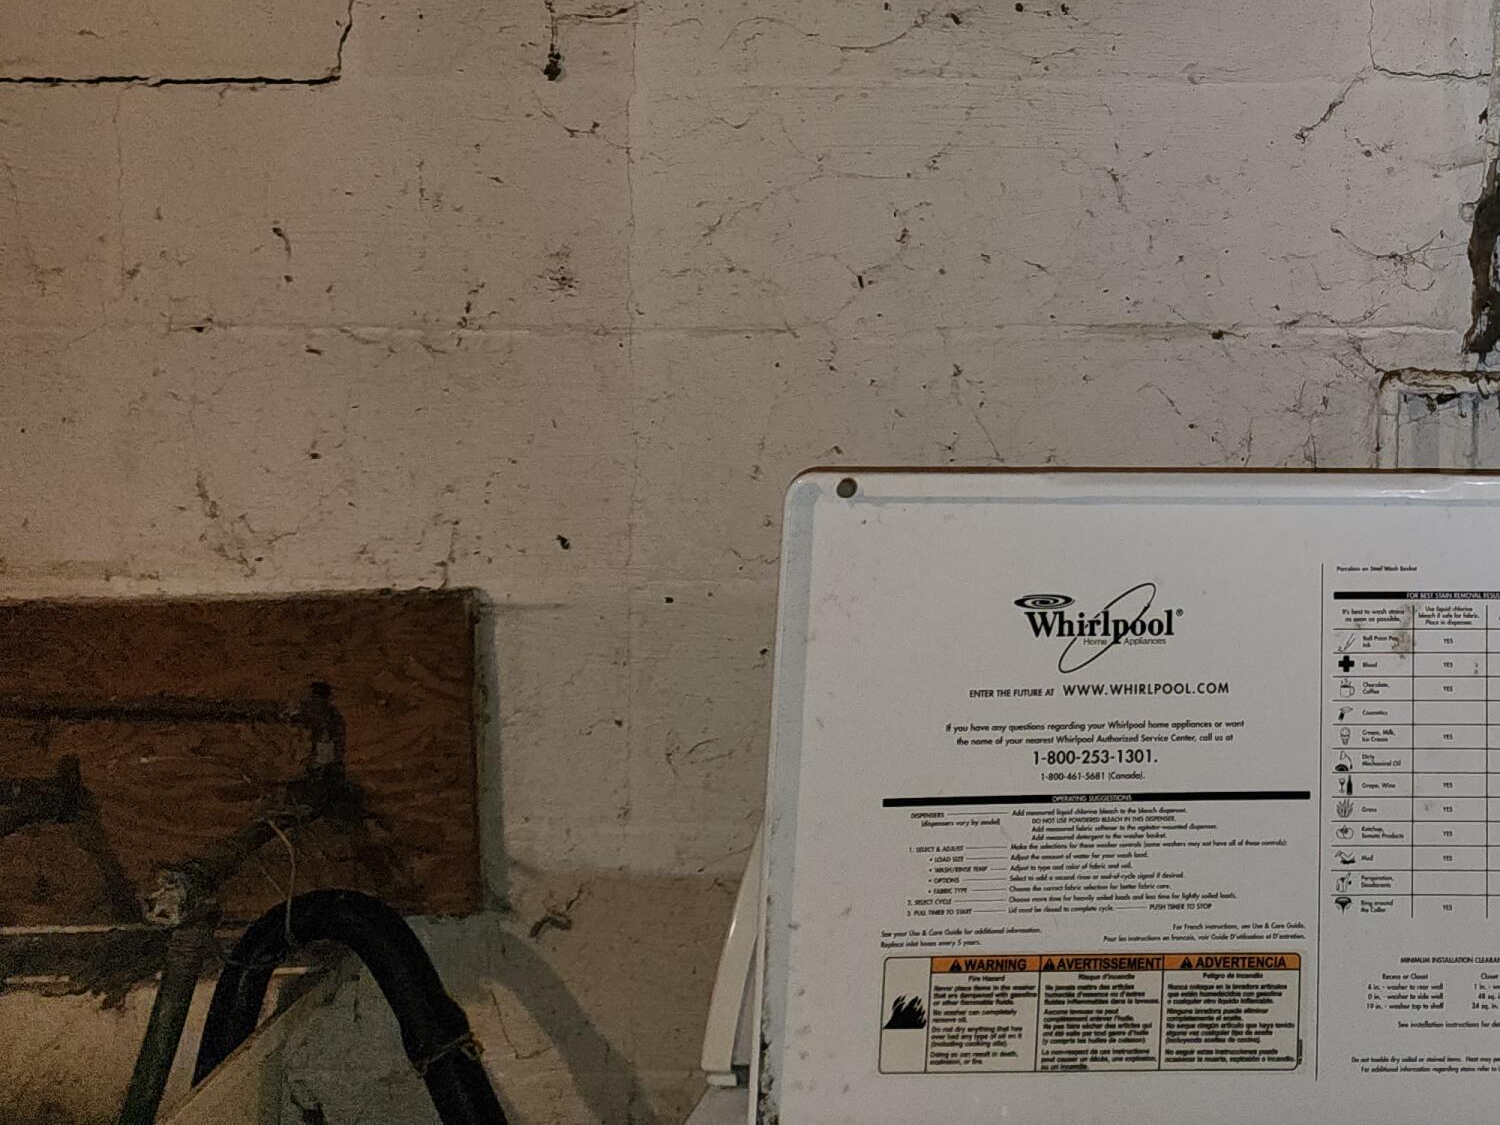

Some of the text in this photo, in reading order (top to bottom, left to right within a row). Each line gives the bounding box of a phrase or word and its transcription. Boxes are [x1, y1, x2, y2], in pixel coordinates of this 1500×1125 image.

[1024, 609, 1175, 644] Whirlpool
[1123, 638, 1166, 646] Appliances
[969, 689, 994, 698] ENTER
[997, 689, 1011, 697] THE
[1013, 689, 1043, 697] FUTURE
[1063, 683, 1229, 695] WWW.WHIRLPOOL.COM
[945, 720, 1245, 734] If you have any questions regarding your Whirlpool home appliances or want
[956, 733, 1234, 746] the name of your nearest Whirlpool Authorized Service Center, call us at
[1034, 750, 1157, 765] 1-800-253-1301.
[1041, 771, 1145, 781] 1-800-461-5681 (Canada).
[965, 959, 1027, 970] WARNING
[1057, 958, 1160, 969] AVERTISSEMENT
[1196, 957, 1286, 968] ADVERTENCIA
